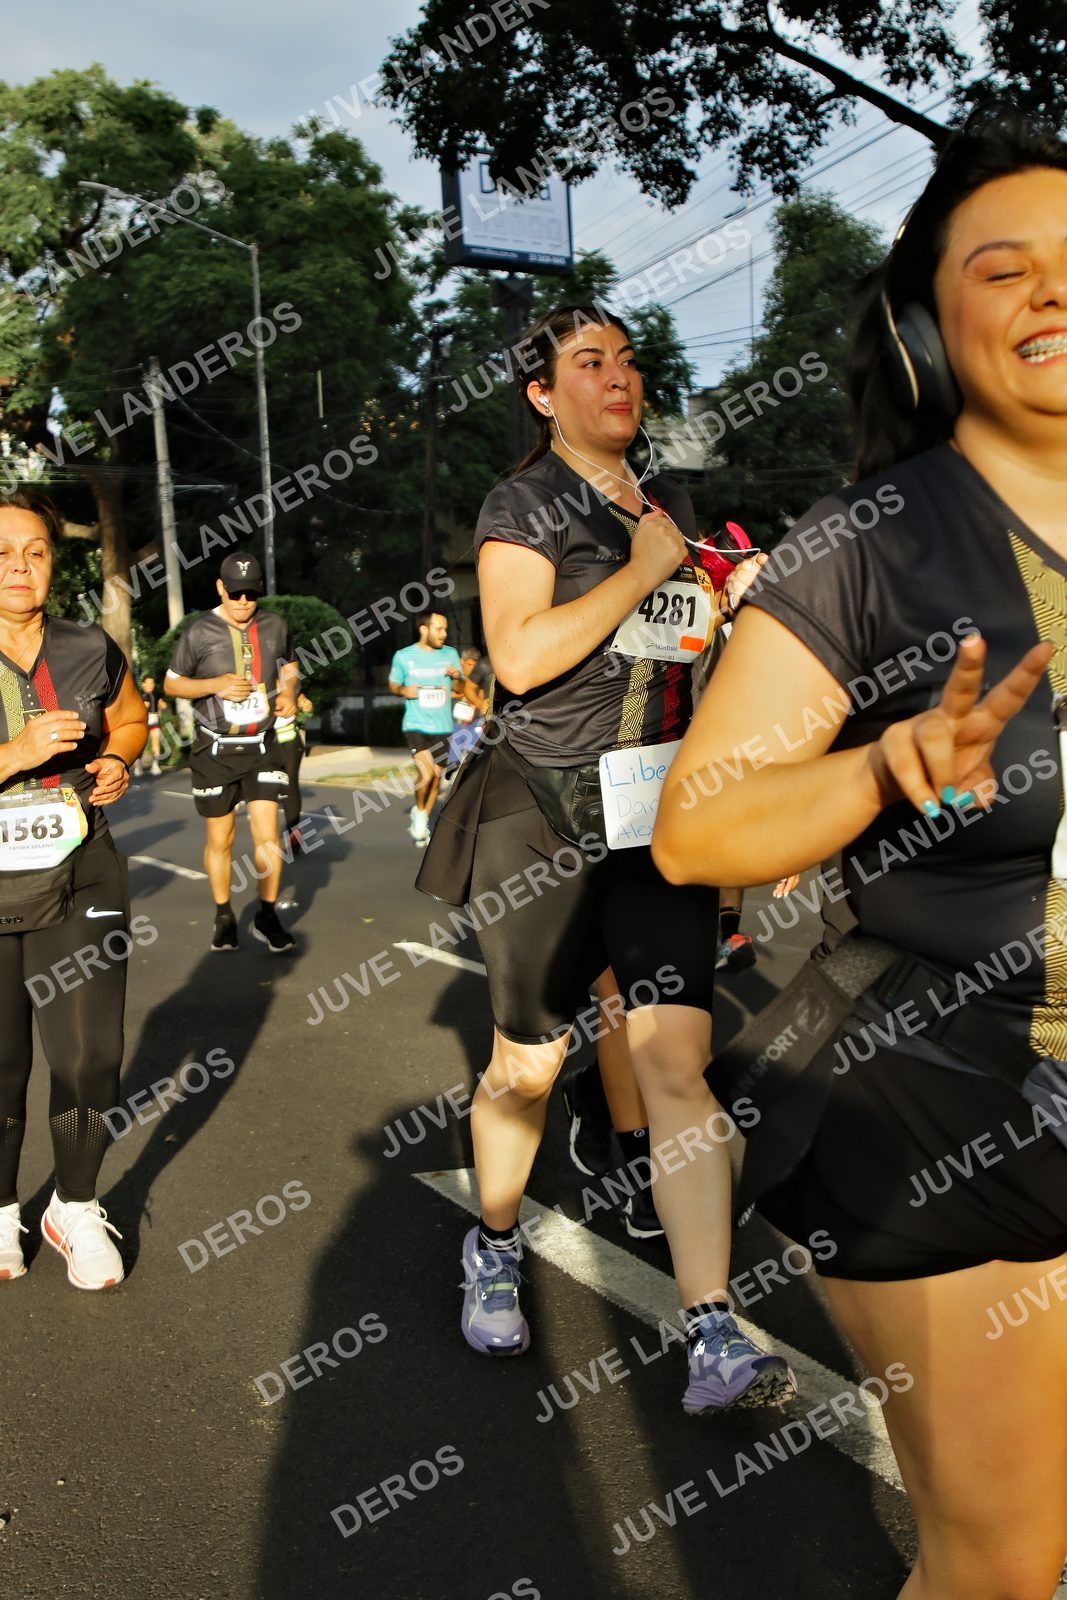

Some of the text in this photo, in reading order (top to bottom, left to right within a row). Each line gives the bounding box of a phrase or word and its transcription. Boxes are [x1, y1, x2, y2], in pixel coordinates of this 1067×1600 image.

[638, 591, 696, 627] 4281
[0, 814, 64, 843] 1563
[750, 1025, 799, 1079] SPORT
